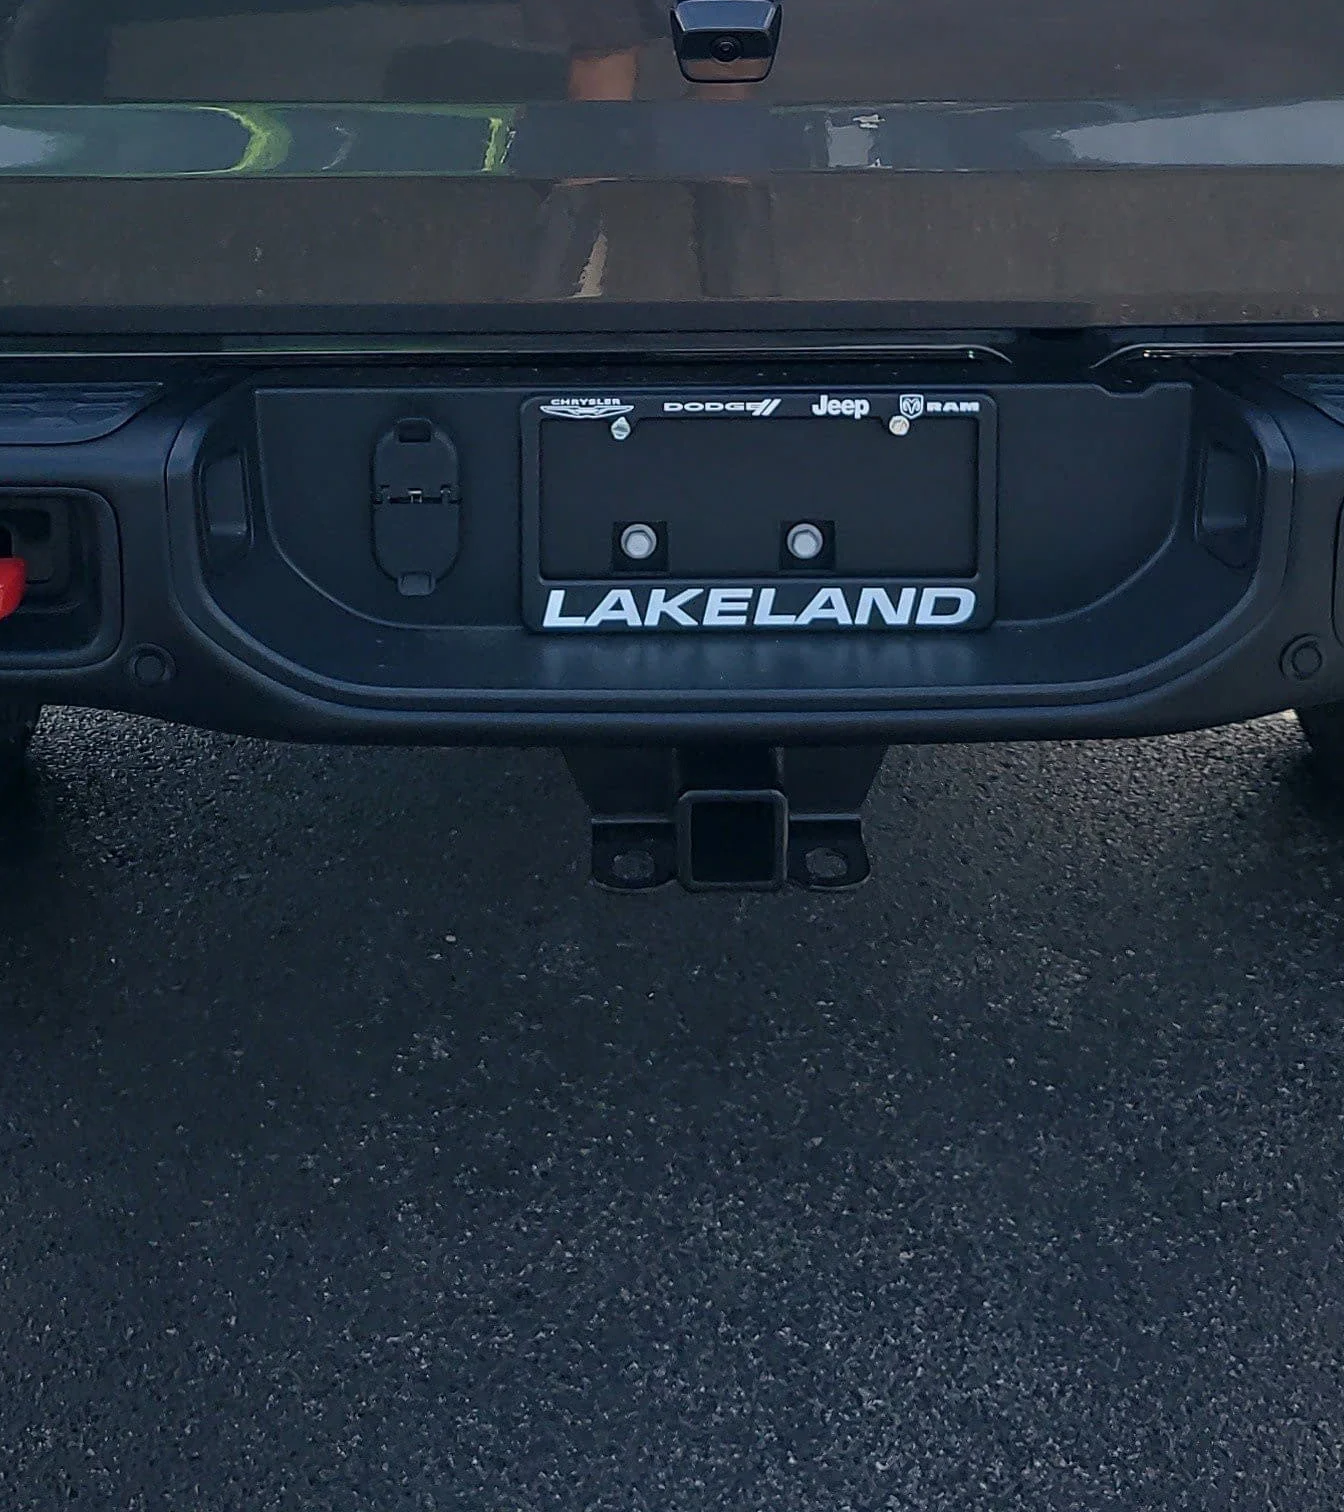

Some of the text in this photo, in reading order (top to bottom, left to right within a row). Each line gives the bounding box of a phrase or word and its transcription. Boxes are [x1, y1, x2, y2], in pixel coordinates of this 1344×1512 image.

[550, 394, 980, 420] CHRYSLER DODGE Jeep RAM
[542, 587, 976, 628] LAKELAND
